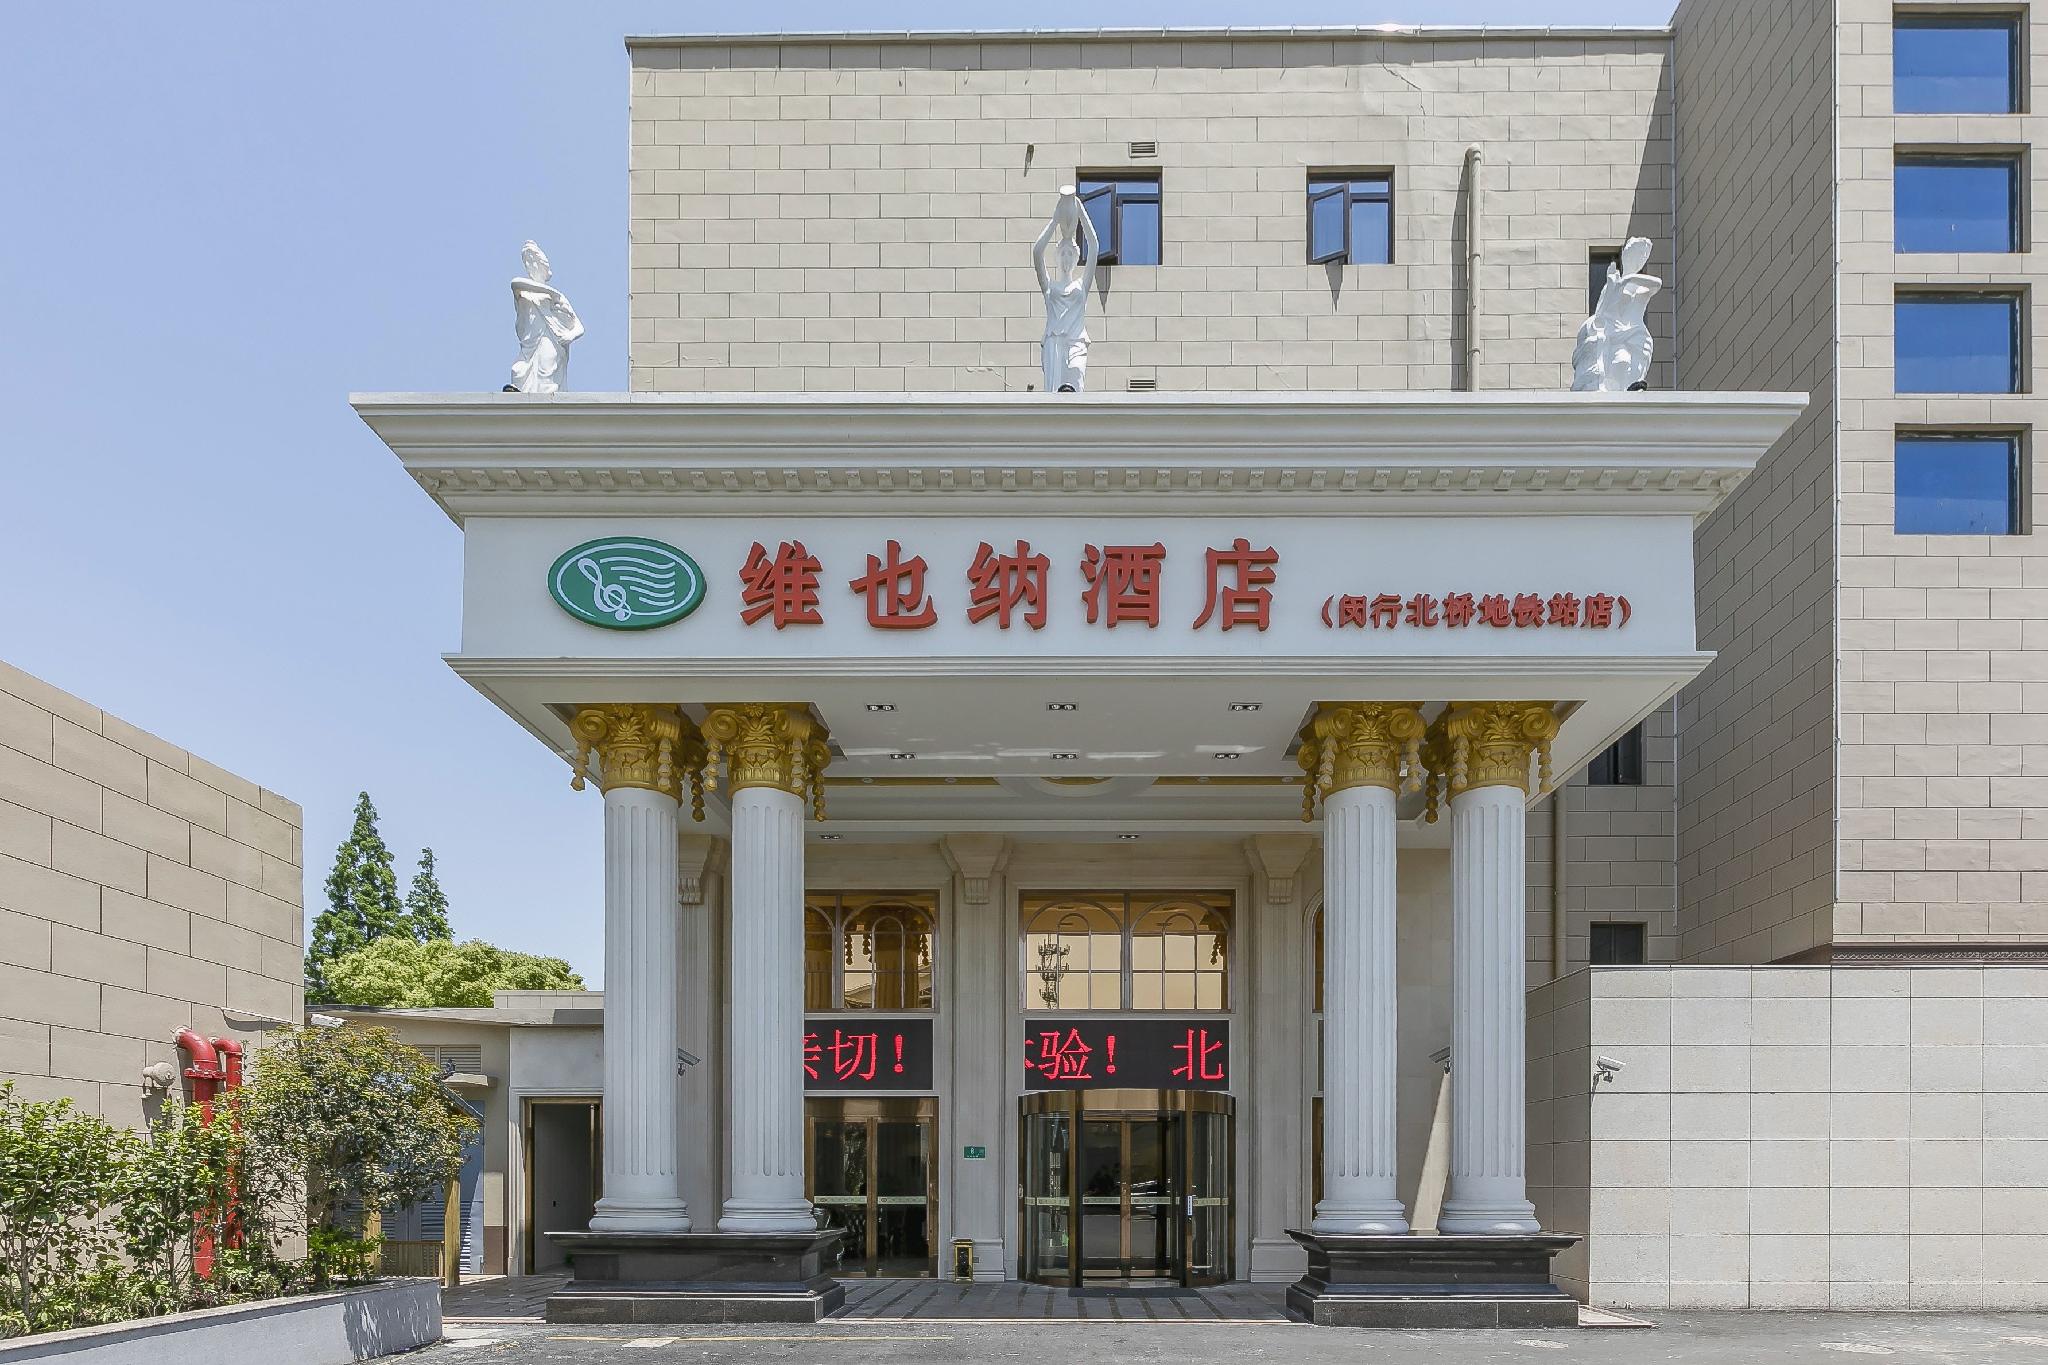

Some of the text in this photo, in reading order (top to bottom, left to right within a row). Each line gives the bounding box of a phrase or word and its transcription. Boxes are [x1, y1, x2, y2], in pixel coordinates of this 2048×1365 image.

[739, 538, 1280, 632] 维也纳酒店
[1025, 1028, 1116, 1079] 验！
[1172, 1028, 1225, 1080] 北
